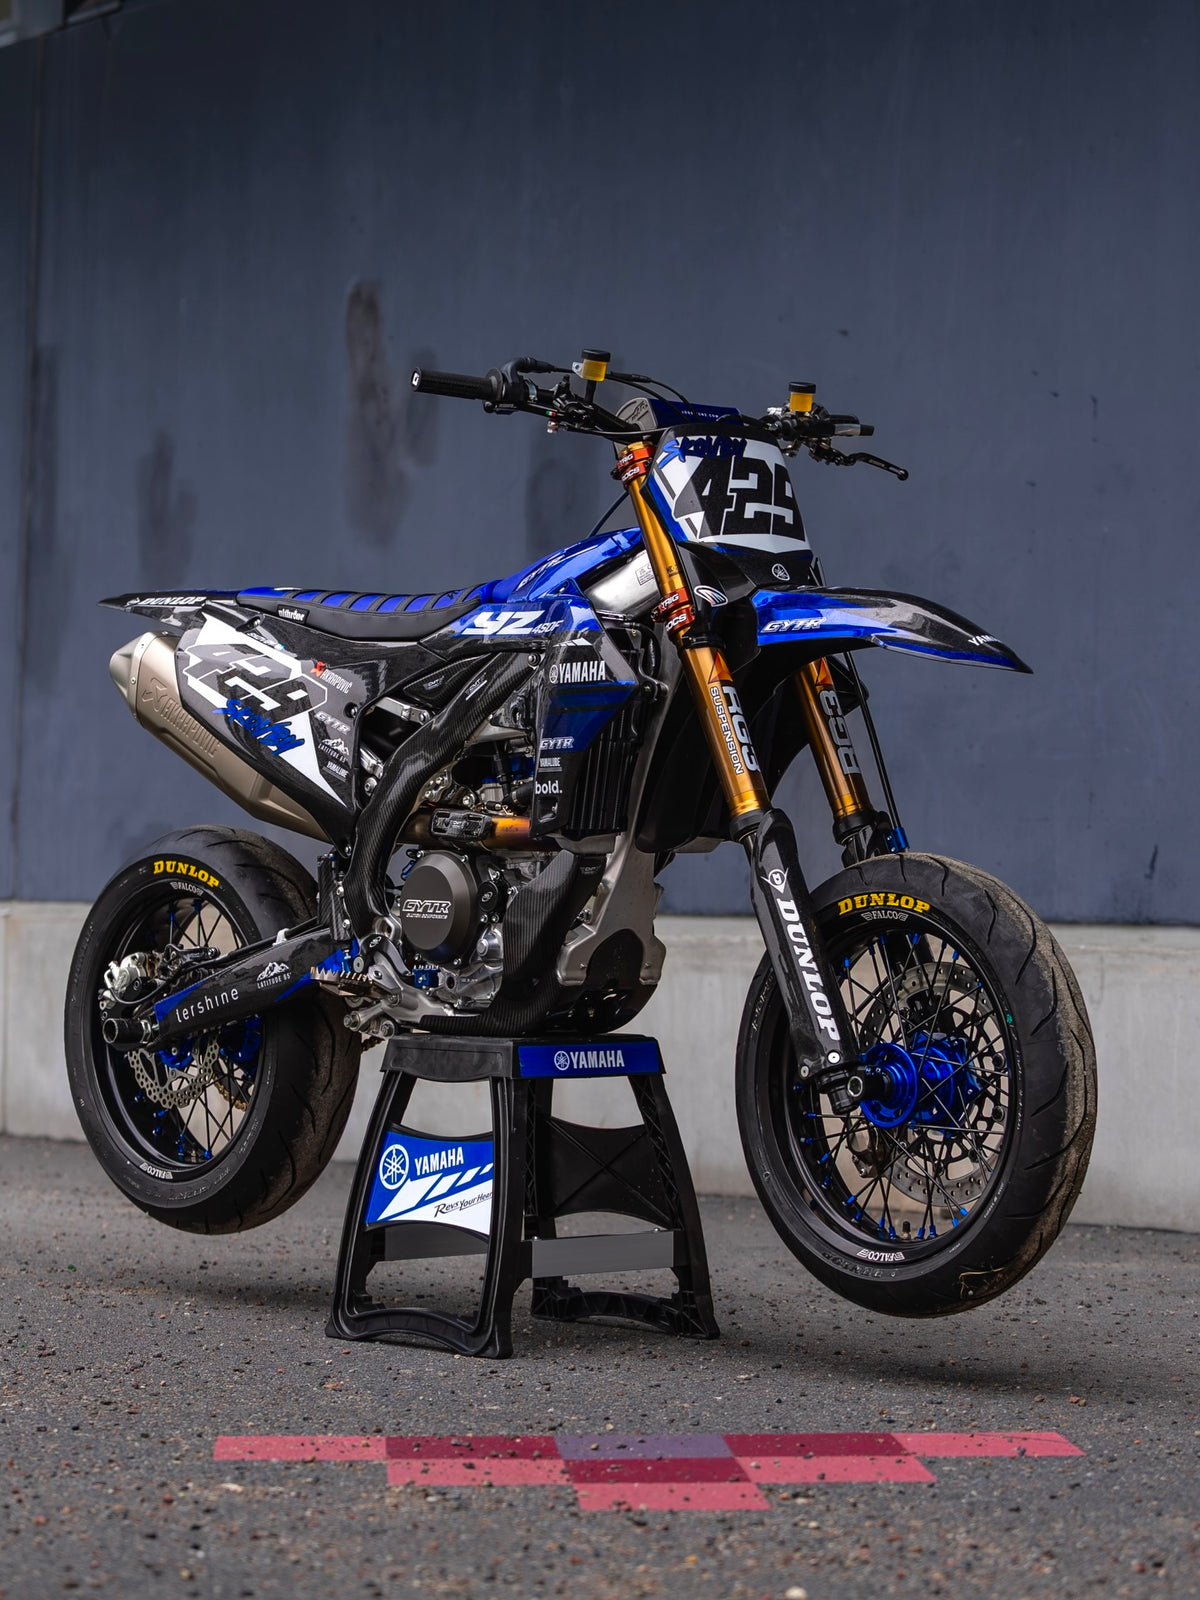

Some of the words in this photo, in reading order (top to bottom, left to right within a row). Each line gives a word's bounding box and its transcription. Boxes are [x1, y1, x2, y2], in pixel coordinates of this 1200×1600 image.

[138, 596, 207, 605] DUNLOP
[462, 610, 545, 636] YZ
[760, 616, 827, 633] GYTR
[559, 660, 606, 684] YAMAHA
[314, 710, 352, 735] GYTR
[710, 686, 744, 776] SUSPENSION
[722, 684, 761, 773] RG3
[819, 688, 862, 776] RG3
[540, 736, 575, 750] GYTR
[535, 780, 563, 794] bold.
[153, 860, 220, 888] DUNLOP
[402, 899, 452, 914] GYTR
[837, 893, 931, 916] DUNLOP
[777, 898, 840, 1041] DUNLOP
[257, 975, 283, 990] LATITUDE
[570, 1050, 625, 1069] YAMAHA
[414, 1146, 465, 1176] YAMAHA
[434, 1201, 459, 1218] Revs
[477, 1191, 494, 1202] Hear
